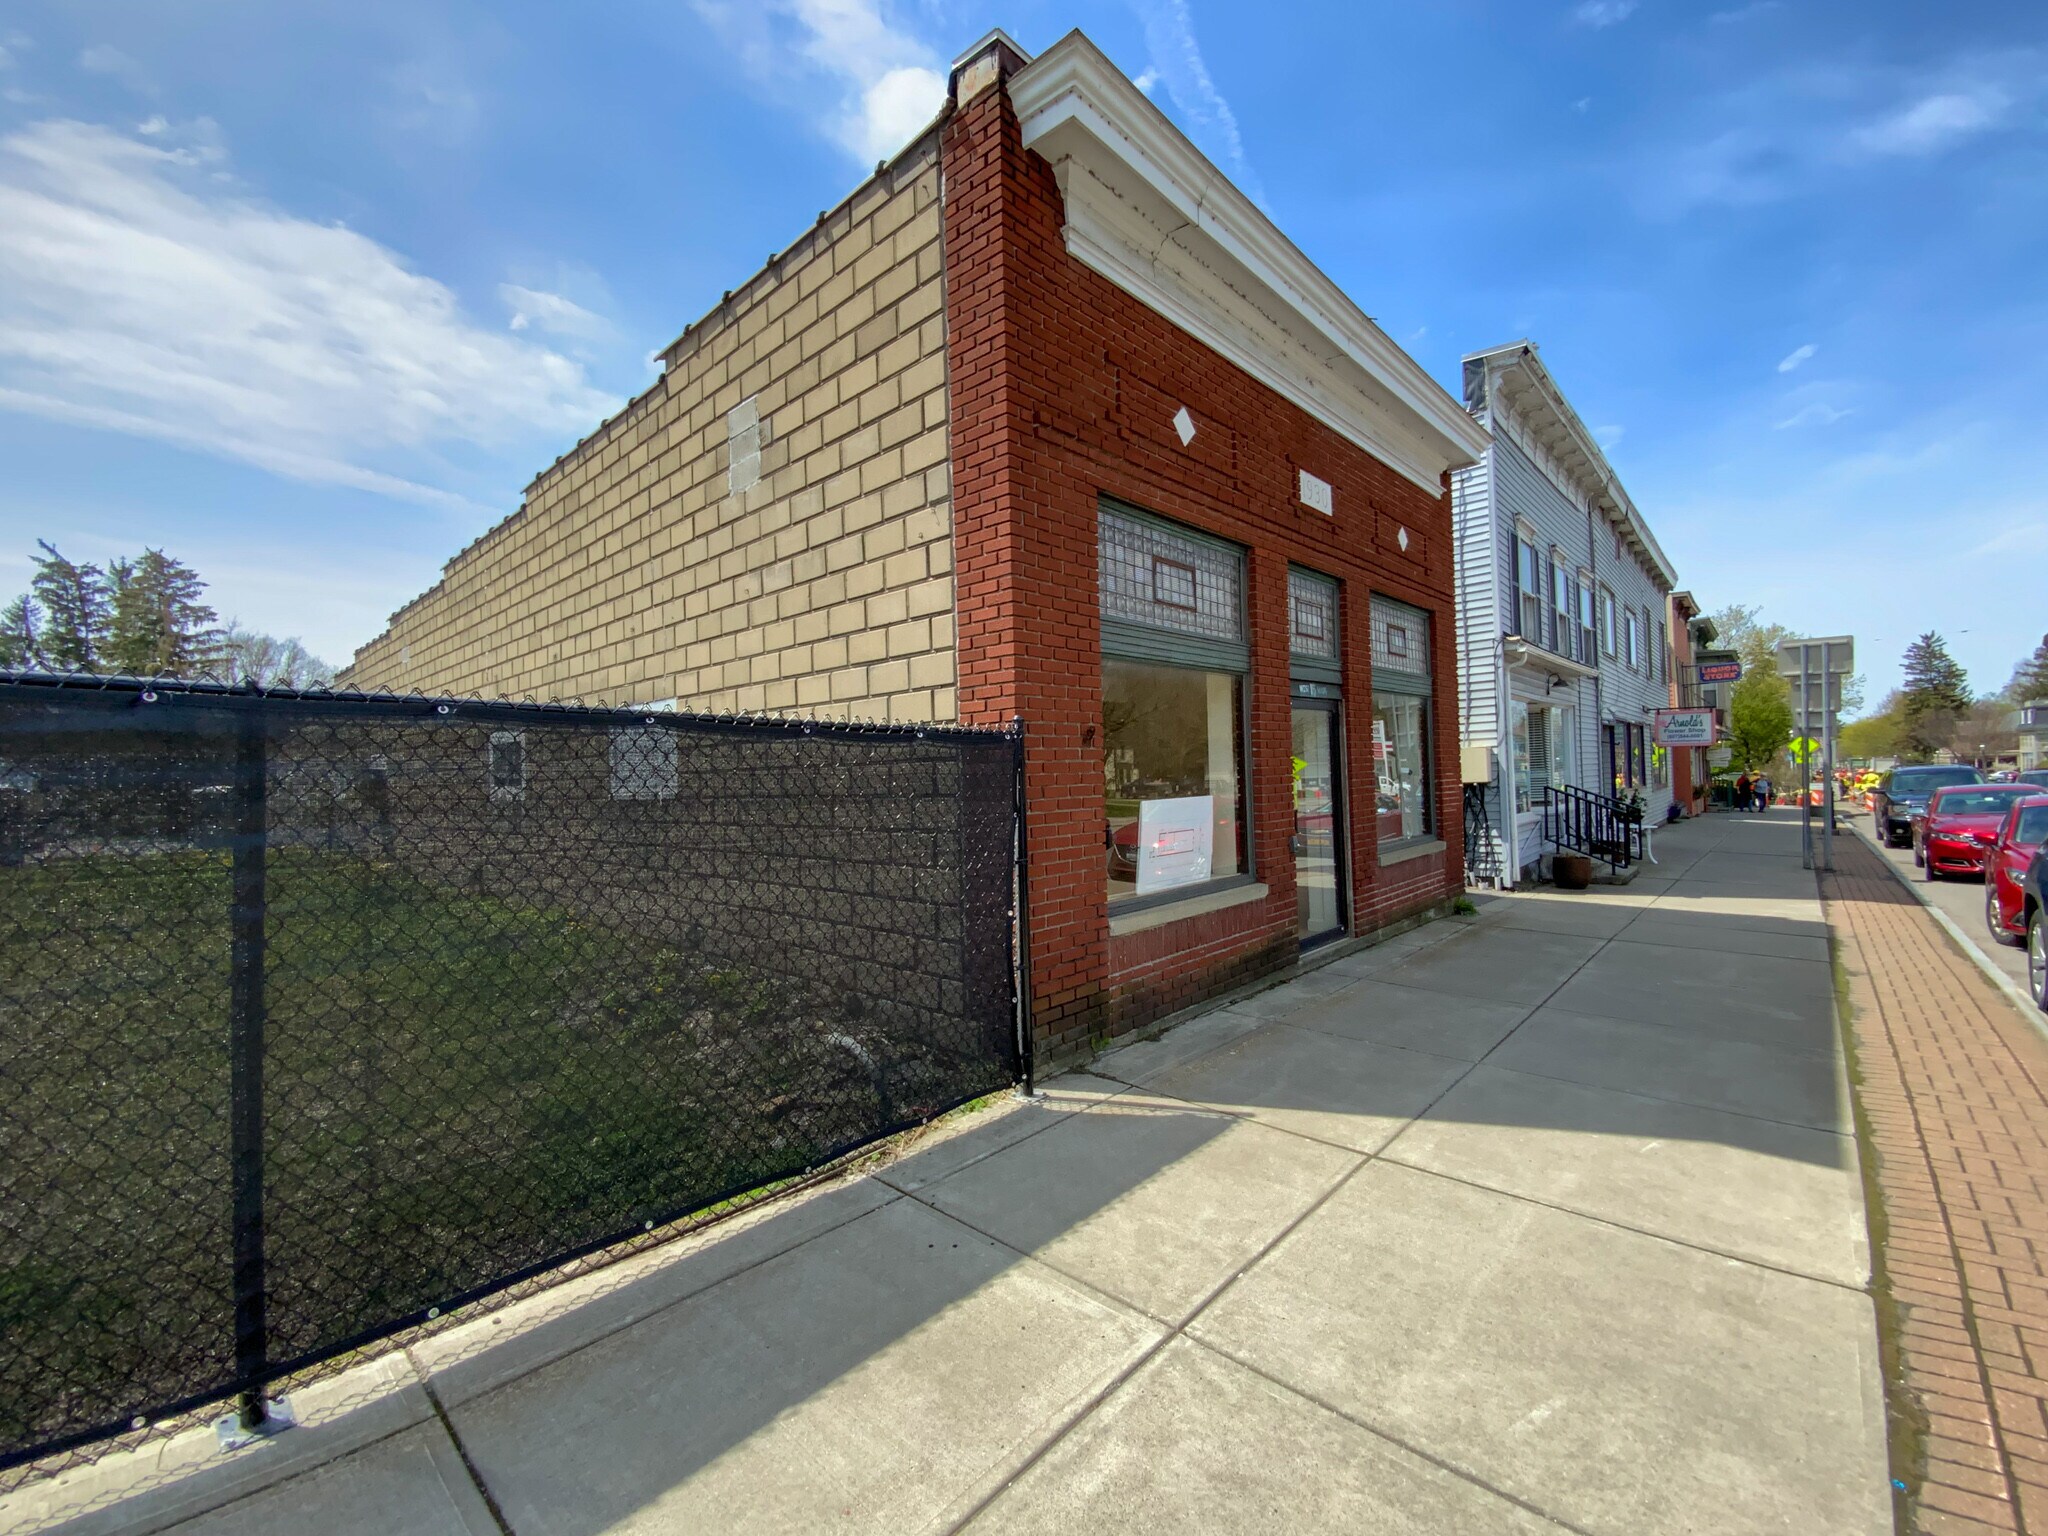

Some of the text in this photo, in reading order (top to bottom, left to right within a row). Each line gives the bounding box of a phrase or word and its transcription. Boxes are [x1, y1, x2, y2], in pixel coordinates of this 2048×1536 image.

[1302, 478, 1328, 508] 1930
[1702, 665, 1739, 673] LIQUOR
[1703, 672, 1736, 680] STORE
[1665, 715, 1703, 728] Arnold's
